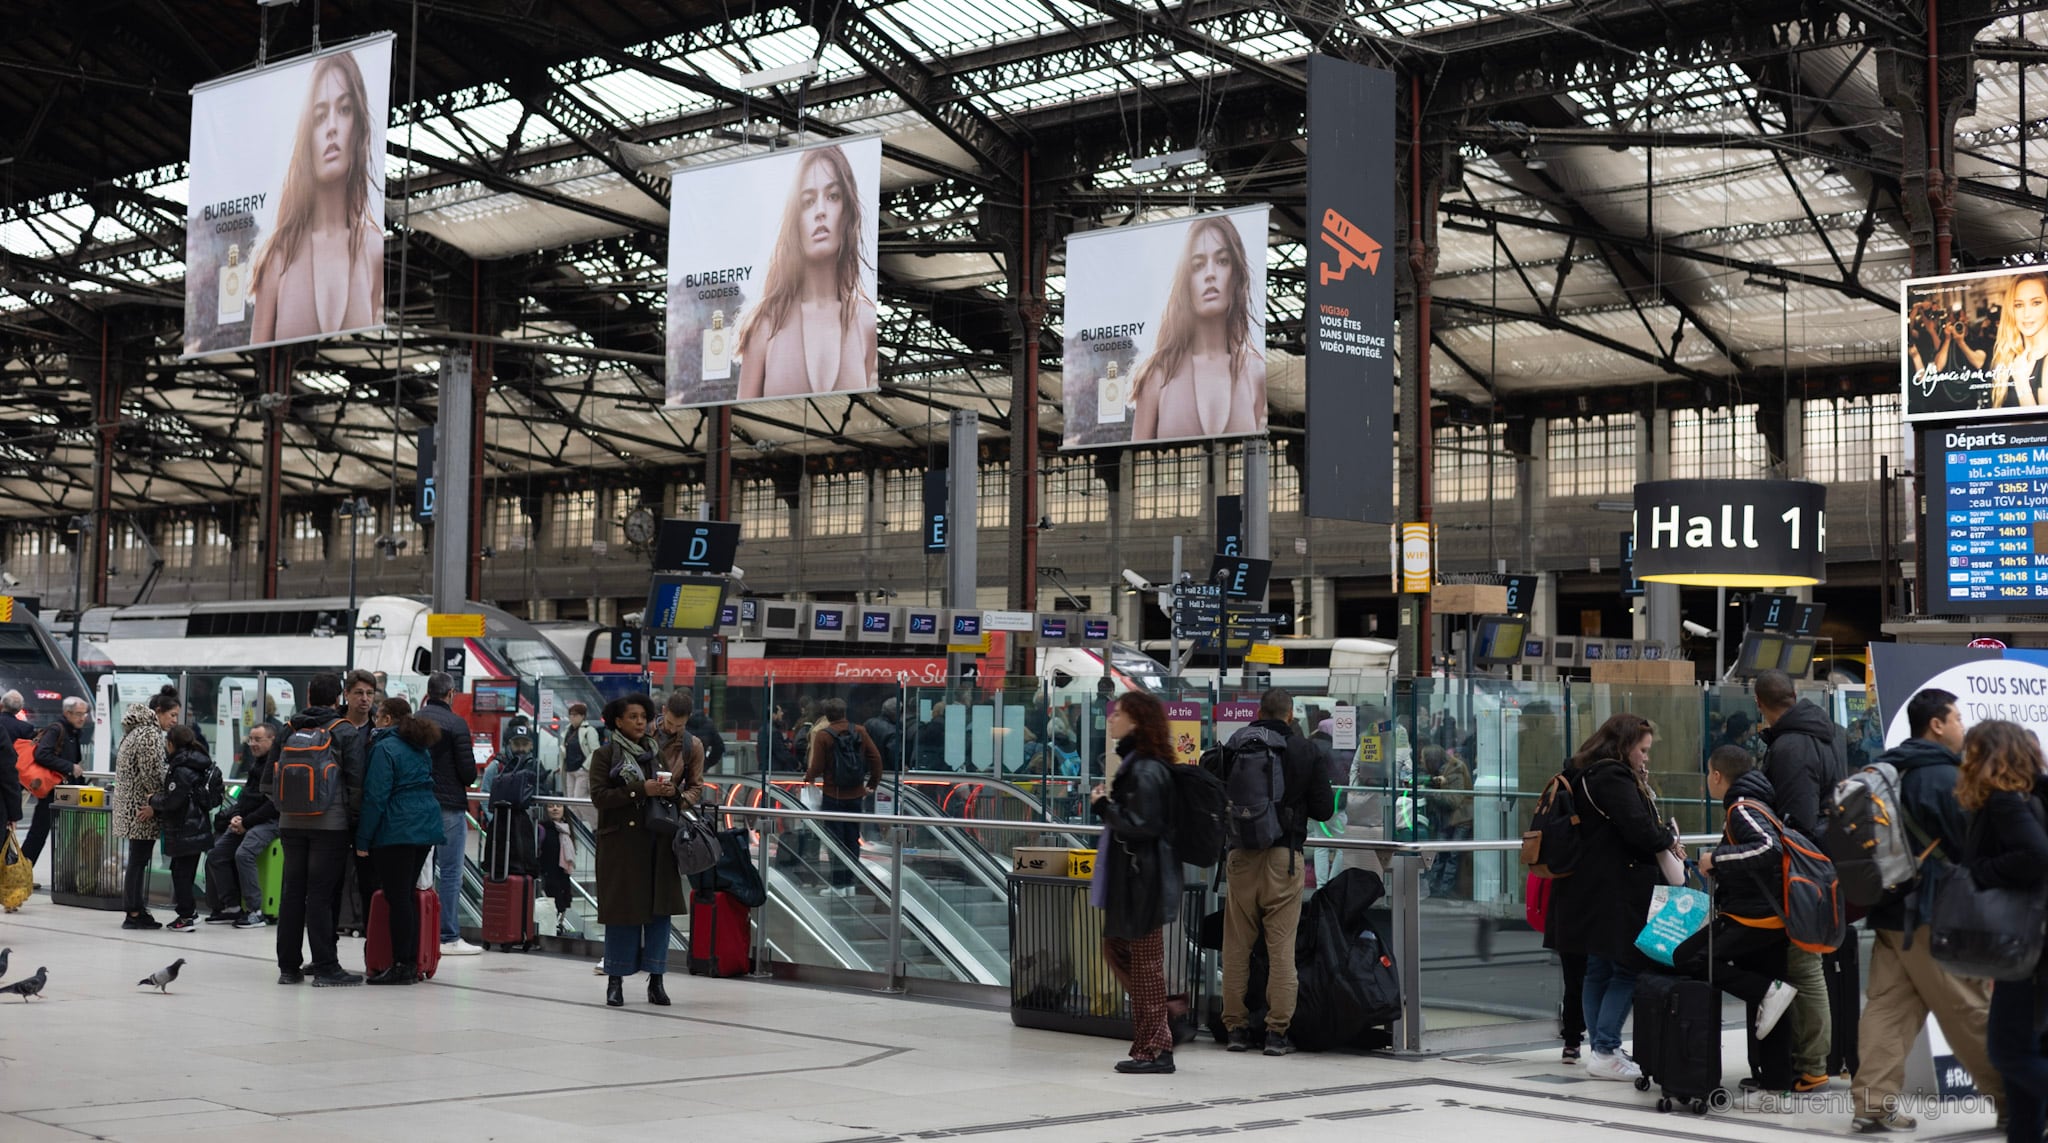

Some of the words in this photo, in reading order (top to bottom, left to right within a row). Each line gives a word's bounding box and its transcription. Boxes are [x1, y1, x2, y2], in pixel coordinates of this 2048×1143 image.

[204, 192, 267, 221] BURBERRY
[215, 216, 254, 234] GODDESS
[686, 266, 752, 288] BURBERRY
[698, 286, 739, 300] GODDESS
[1320, 315, 1342, 327] VOUS
[1343, 317, 1361, 330] ÊTES
[1081, 322, 1145, 341] BURBERRY
[1320, 328, 1342, 340] DANS
[1343, 332, 1355, 342] UN
[1357, 334, 1385, 347] ESPACE
[1093, 340, 1133, 353] GODDESS
[1320, 341, 1344, 353] VIDÉO
[1945, 432, 2006, 450] Départs
[2010, 436, 2047, 444] Departures
[1998, 452, 2028, 464] 13h46
[1998, 482, 2028, 494] 13h52
[423, 488, 435, 509] D
[1994, 495, 2015, 507] TGV
[1999, 512, 2027, 522] 14h10
[934, 523, 944, 543] E
[1651, 505, 1759, 549] Hall
[1781, 507, 1801, 549] 1
[1999, 527, 2027, 537] 14h10
[689, 537, 707, 560] D
[1999, 542, 2027, 552] 14h14
[2000, 557, 2027, 567] 14h16
[1232, 571, 1248, 590] E
[2000, 572, 2027, 582] 14h18
[1197, 586, 1201, 594] 2
[2000, 587, 2028, 597] 14h22
[667, 586, 681, 628] circulation
[1189, 600, 1200, 608] Hall
[1201, 600, 1205, 608] 3
[1767, 605, 1780, 622] H
[620, 640, 632, 657] G
[655, 641, 667, 656] H
[1967, 676, 2006, 694] TOUS
[2010, 677, 2047, 695] SNCF
[1168, 708, 1178, 717] Je
[1179, 707, 1192, 716] trie
[1224, 708, 1234, 718] Je
[1235, 708, 1254, 718] jette
[1967, 702, 2006, 721] TOUS
[2010, 704, 2048, 723] RUGB
[1946, 1067, 1978, 1090] #Ru
